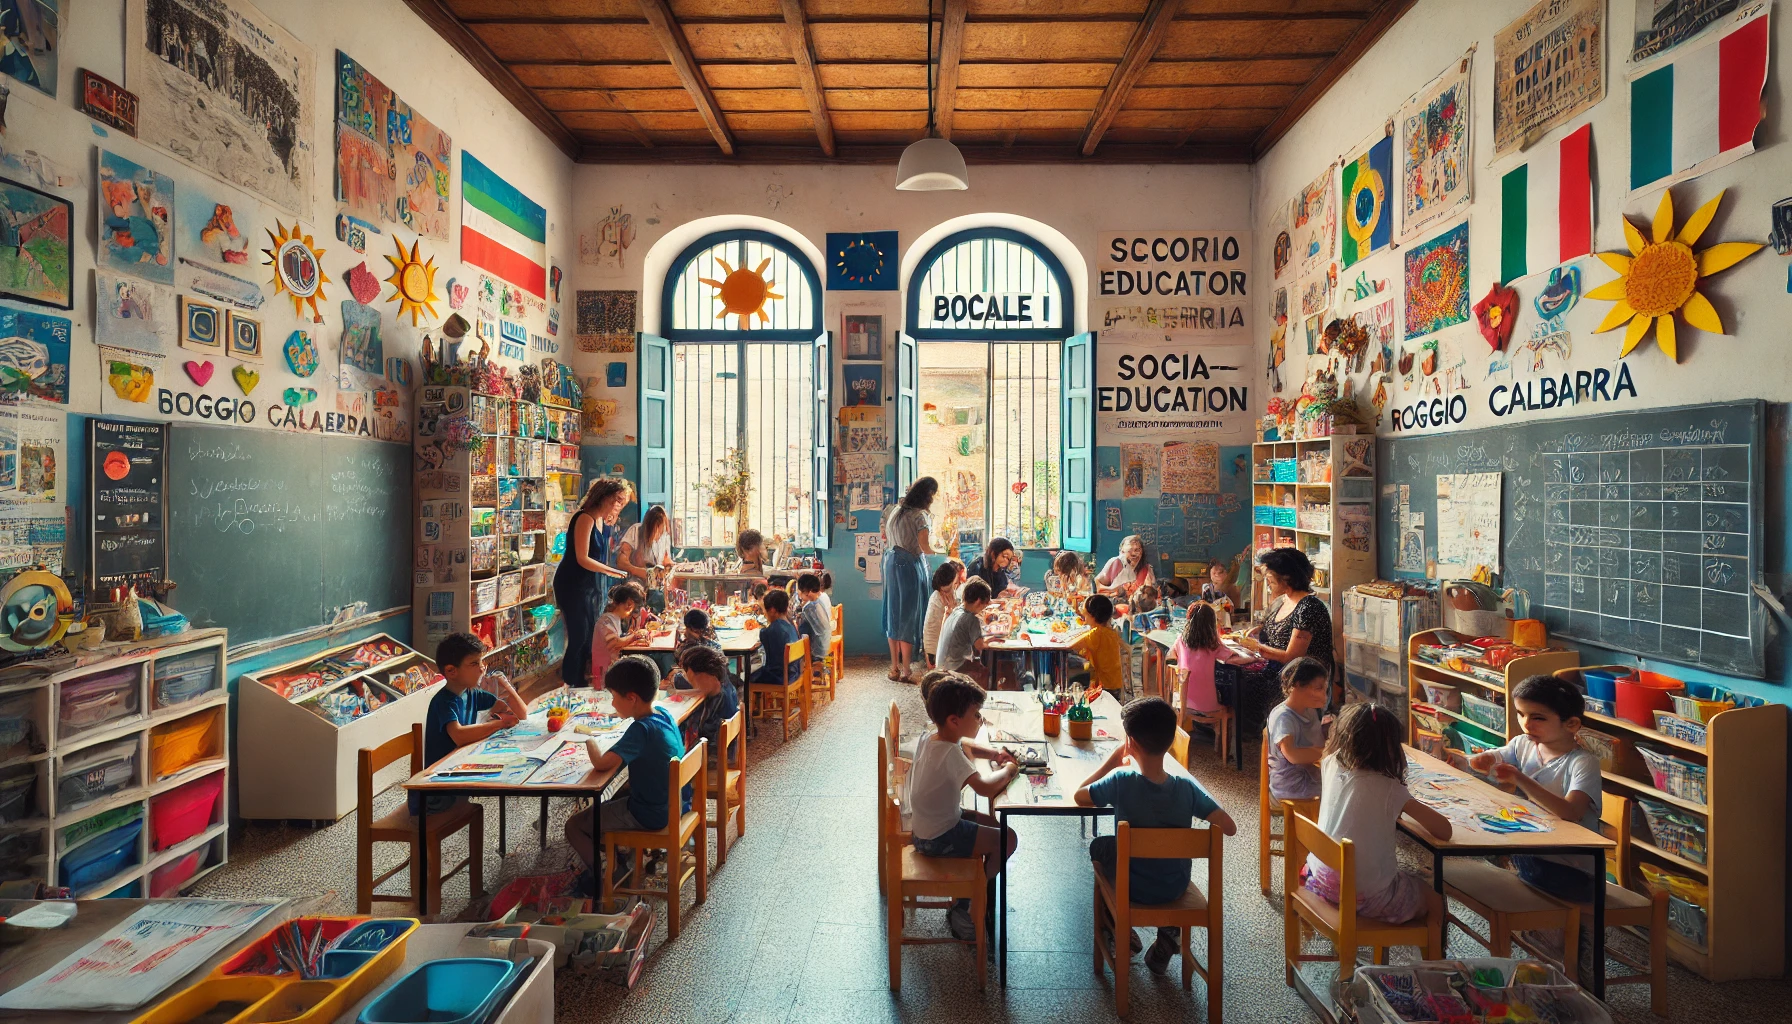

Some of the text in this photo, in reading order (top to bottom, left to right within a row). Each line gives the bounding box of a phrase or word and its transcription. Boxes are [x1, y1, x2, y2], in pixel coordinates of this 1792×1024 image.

[1100, 270, 1247, 297] EDUCATOR
[934, 294, 1033, 322] BOCALE
[158, 388, 256, 424] BOGGIO
[1098, 385, 1248, 413] EDUCATION
[1391, 394, 1468, 432] ROGGIO
